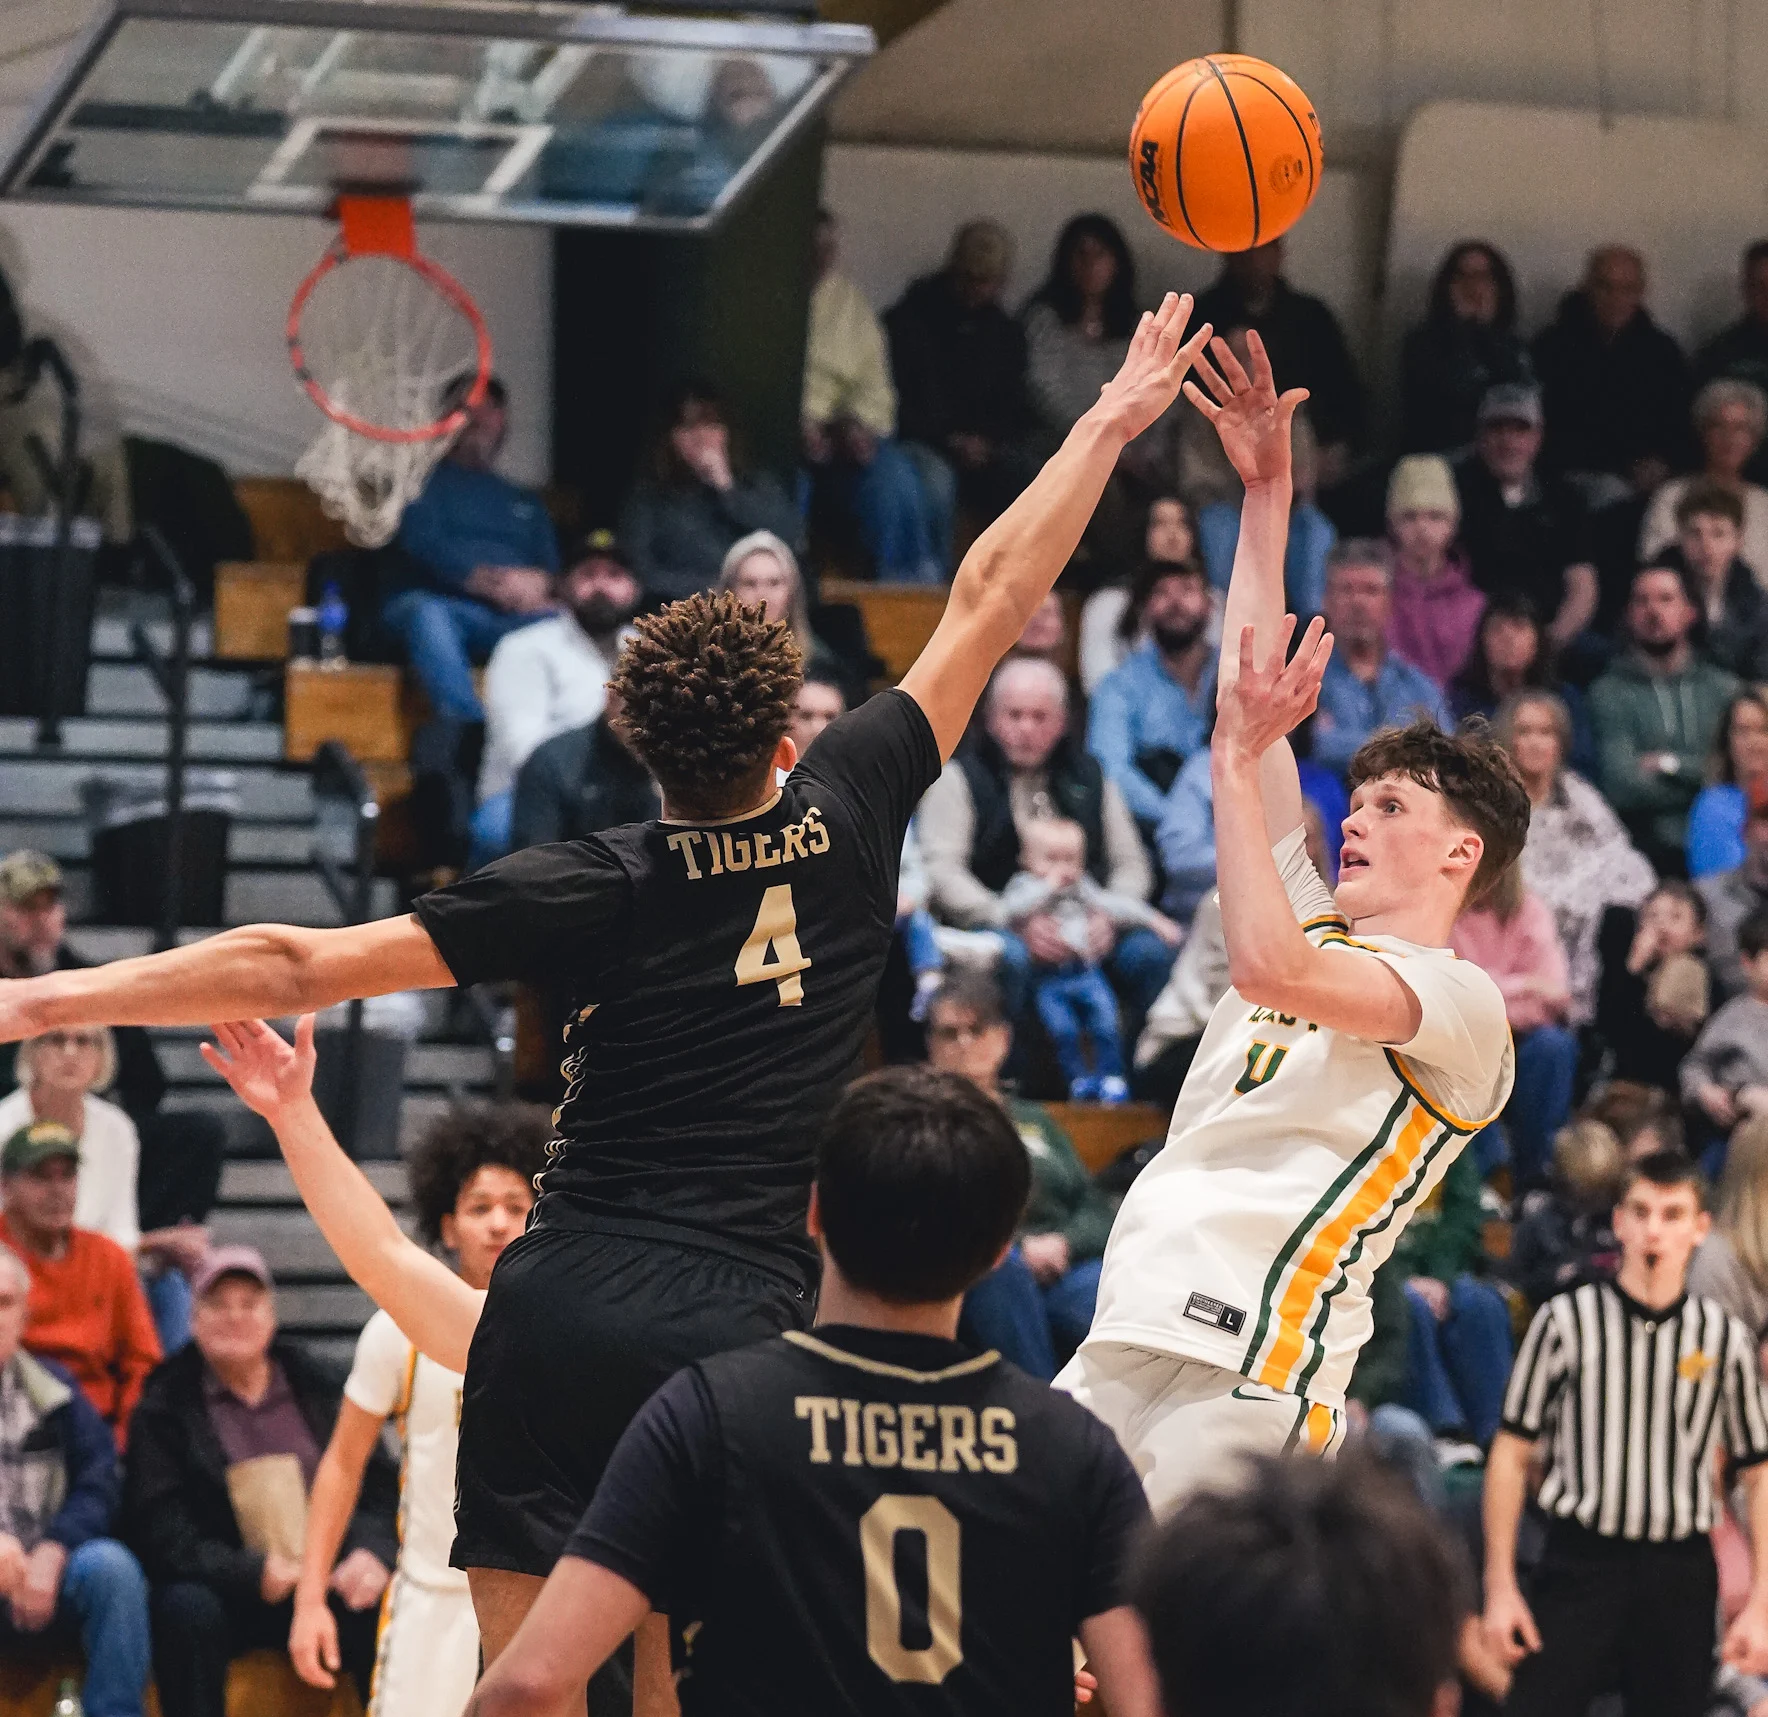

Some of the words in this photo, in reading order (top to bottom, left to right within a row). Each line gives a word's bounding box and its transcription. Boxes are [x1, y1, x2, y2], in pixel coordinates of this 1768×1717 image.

[666, 806, 831, 880] TIGERS
[733, 883, 813, 1008] 4
[1226, 1313, 1234, 1326] L
[794, 1395, 1020, 1475] TIGERS
[859, 1493, 964, 1686] 0
